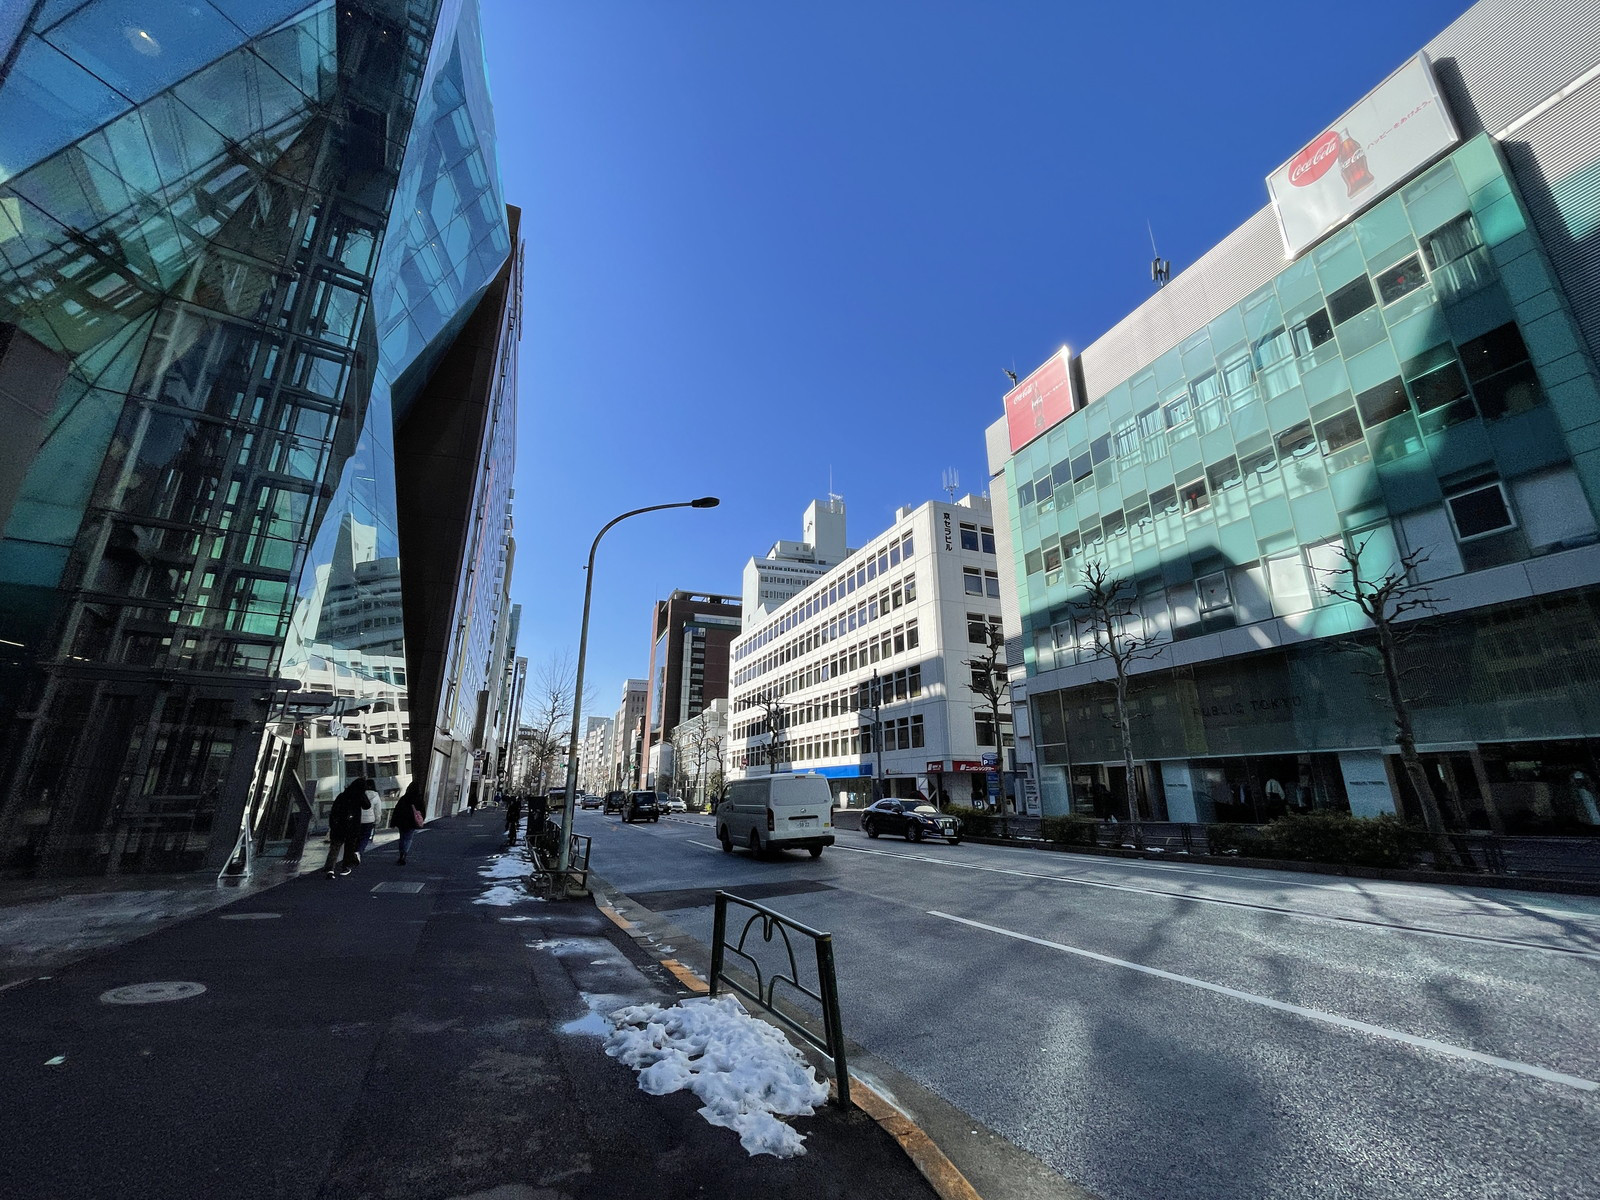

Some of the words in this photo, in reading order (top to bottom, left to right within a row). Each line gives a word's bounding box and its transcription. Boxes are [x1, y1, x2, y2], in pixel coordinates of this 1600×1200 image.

[943, 512, 953, 552] 京セラビル
